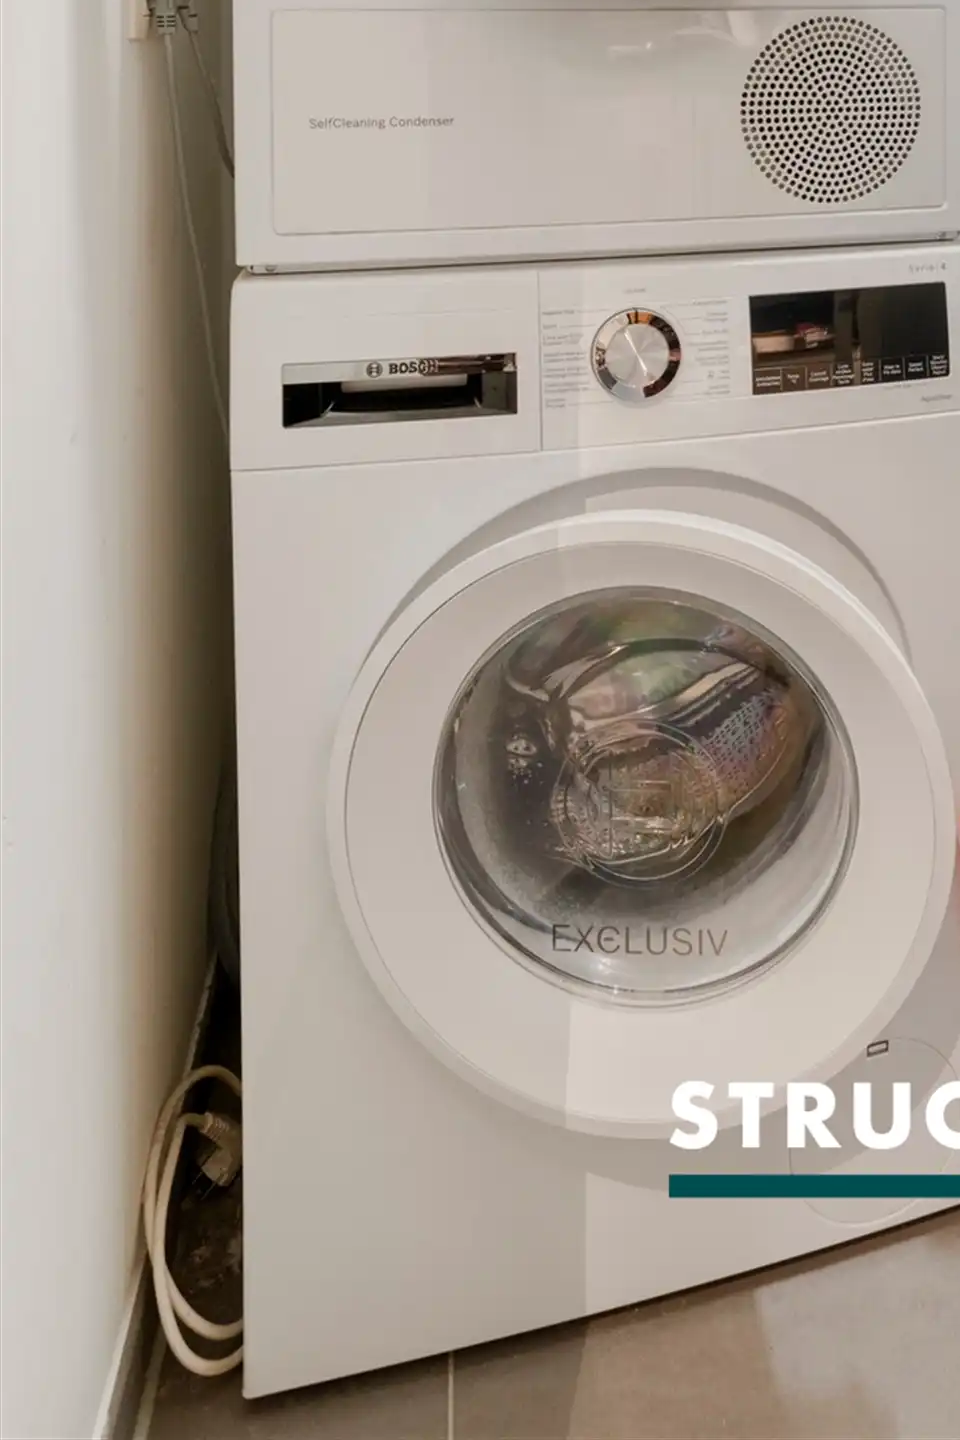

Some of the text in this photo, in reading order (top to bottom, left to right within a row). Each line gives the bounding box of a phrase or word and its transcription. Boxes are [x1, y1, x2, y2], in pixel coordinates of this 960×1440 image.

[308, 115, 455, 130] SelfCleaning Condenser
[388, 359, 439, 375] BOSCH
